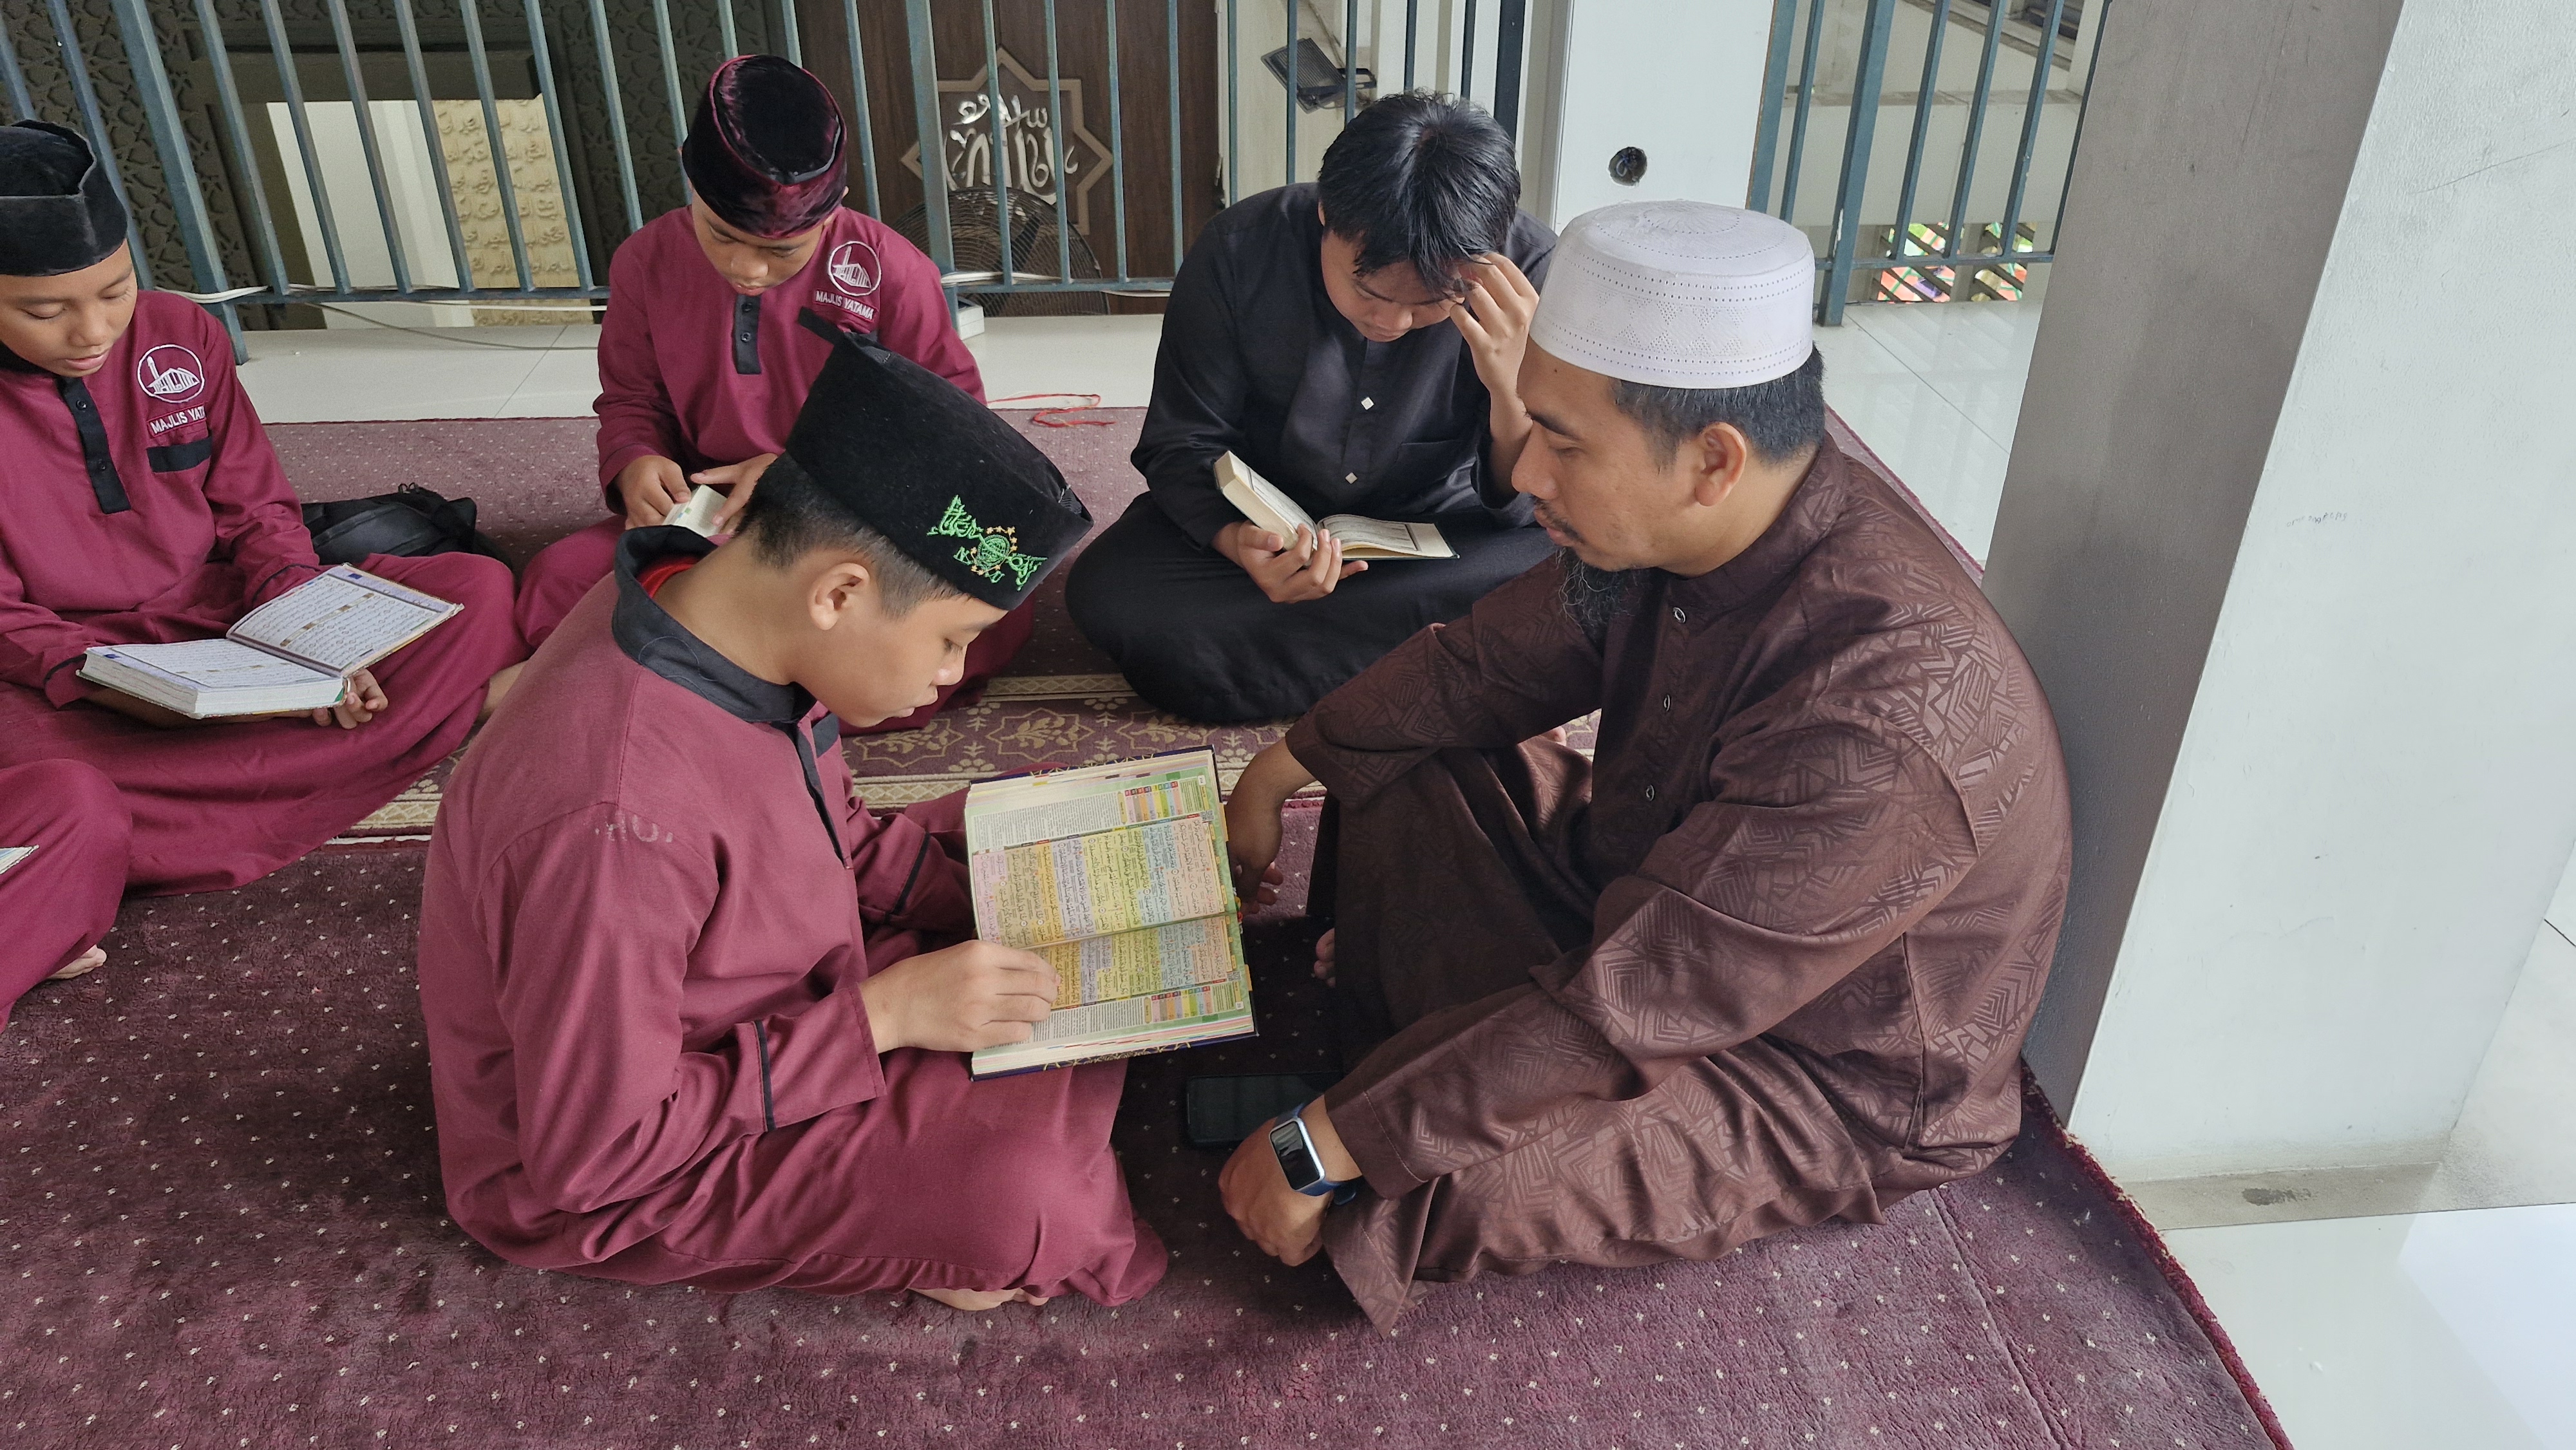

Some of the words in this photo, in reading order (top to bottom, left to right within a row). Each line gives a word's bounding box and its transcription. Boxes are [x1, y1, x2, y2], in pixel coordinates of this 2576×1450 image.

[816, 290, 842, 306] MAJLIS
[844, 297, 875, 320] YATAMA
[151, 412, 188, 433] MAJLIS
